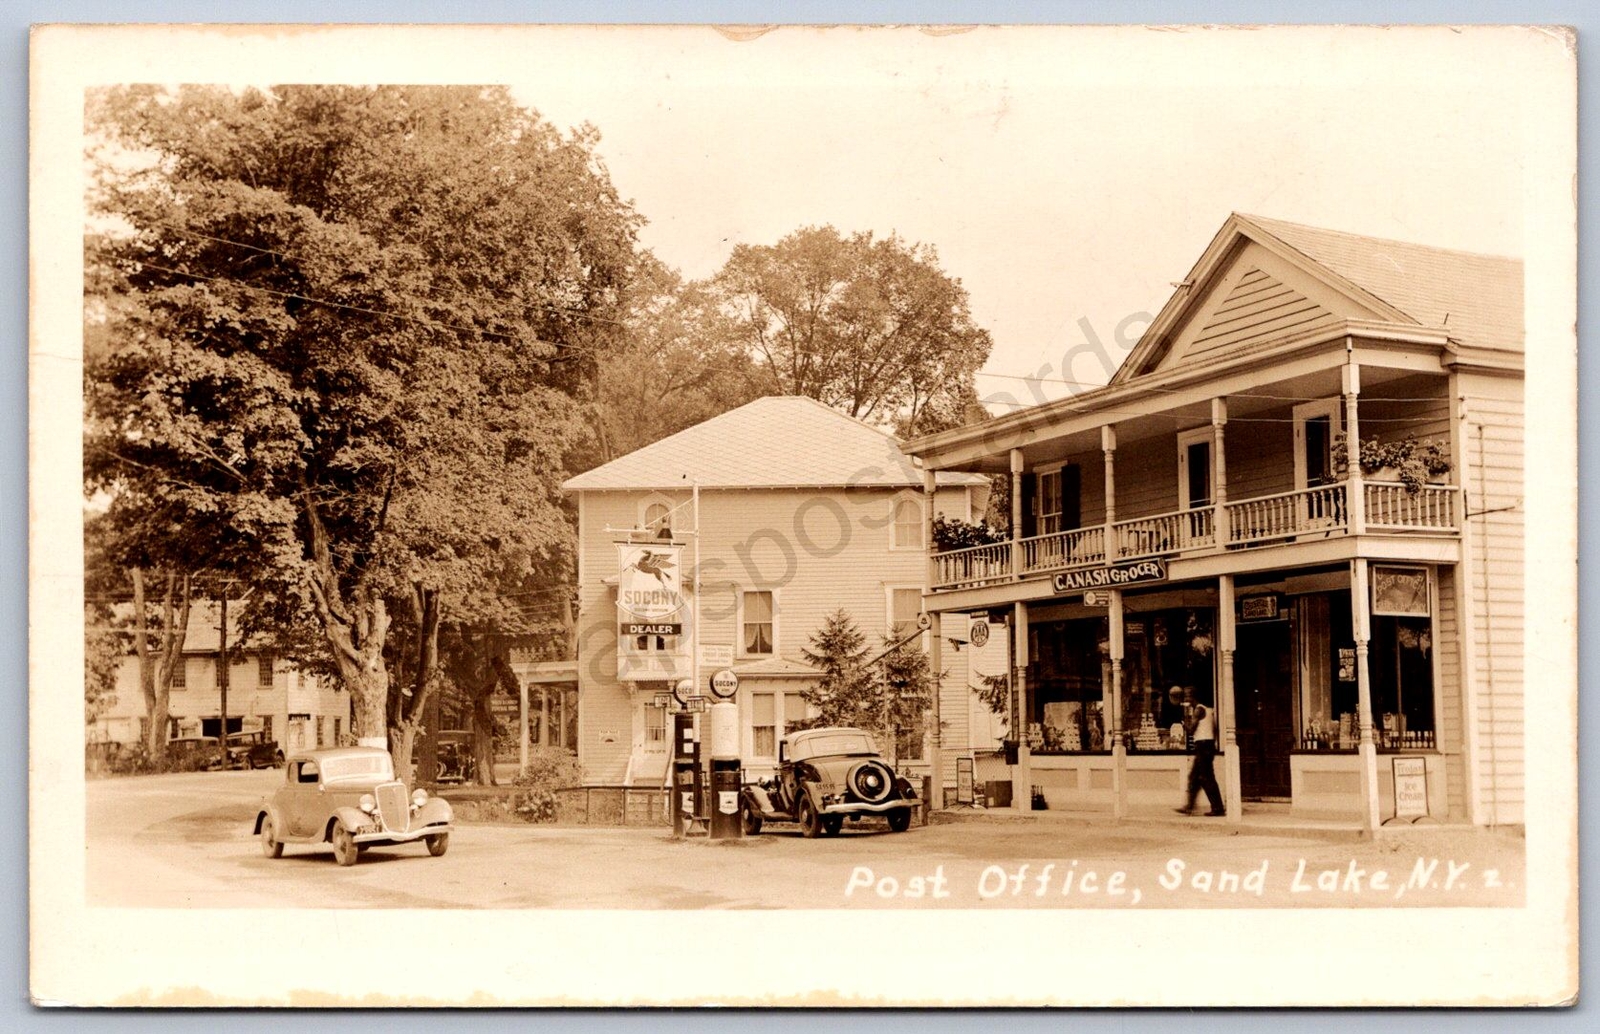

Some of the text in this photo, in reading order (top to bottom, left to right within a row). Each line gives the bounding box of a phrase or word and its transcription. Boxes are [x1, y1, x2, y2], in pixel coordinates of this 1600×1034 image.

[1110, 562, 1160, 583] GROCER
[624, 590, 679, 606] SOCONY
[629, 625, 673, 634] DEALER
[714, 680, 737, 688] SOCONY
[677, 687, 693, 695] SOCO
